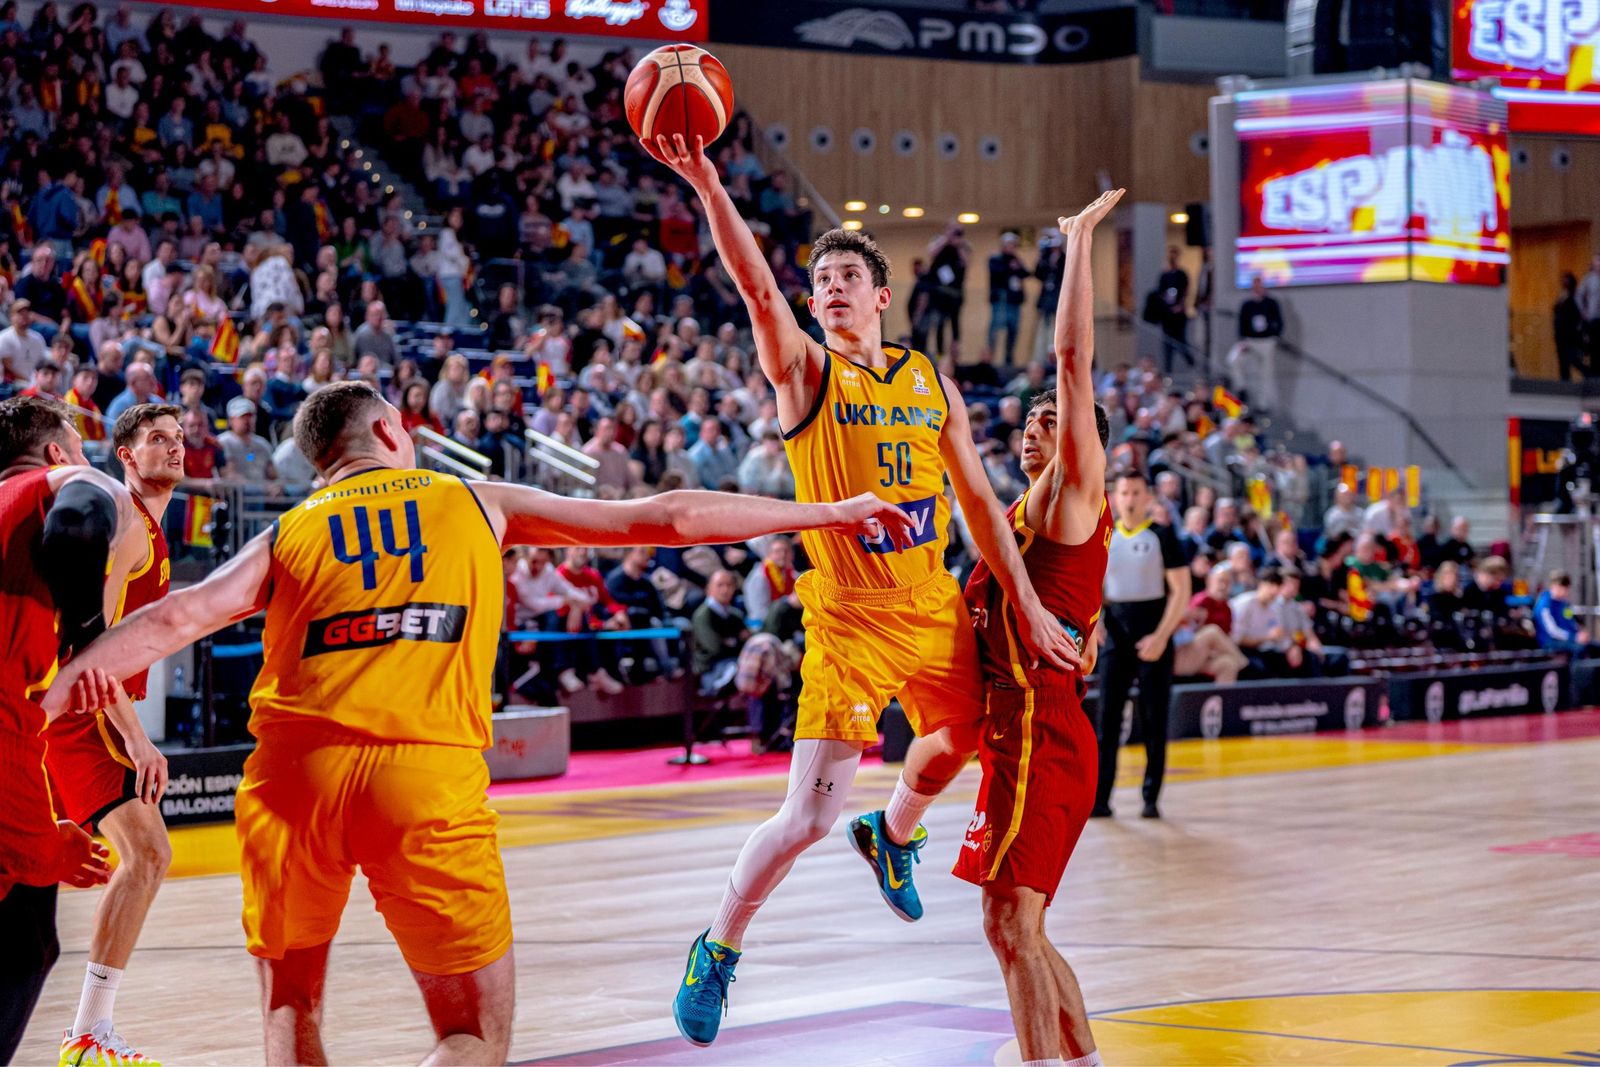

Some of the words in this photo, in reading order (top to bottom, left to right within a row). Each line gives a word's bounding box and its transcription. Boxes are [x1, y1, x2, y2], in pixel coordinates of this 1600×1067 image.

[1470, 0, 1600, 75] ESP
[834, 401, 943, 431] UKRAINE
[877, 441, 912, 487] 50
[328, 500, 428, 591] 44
